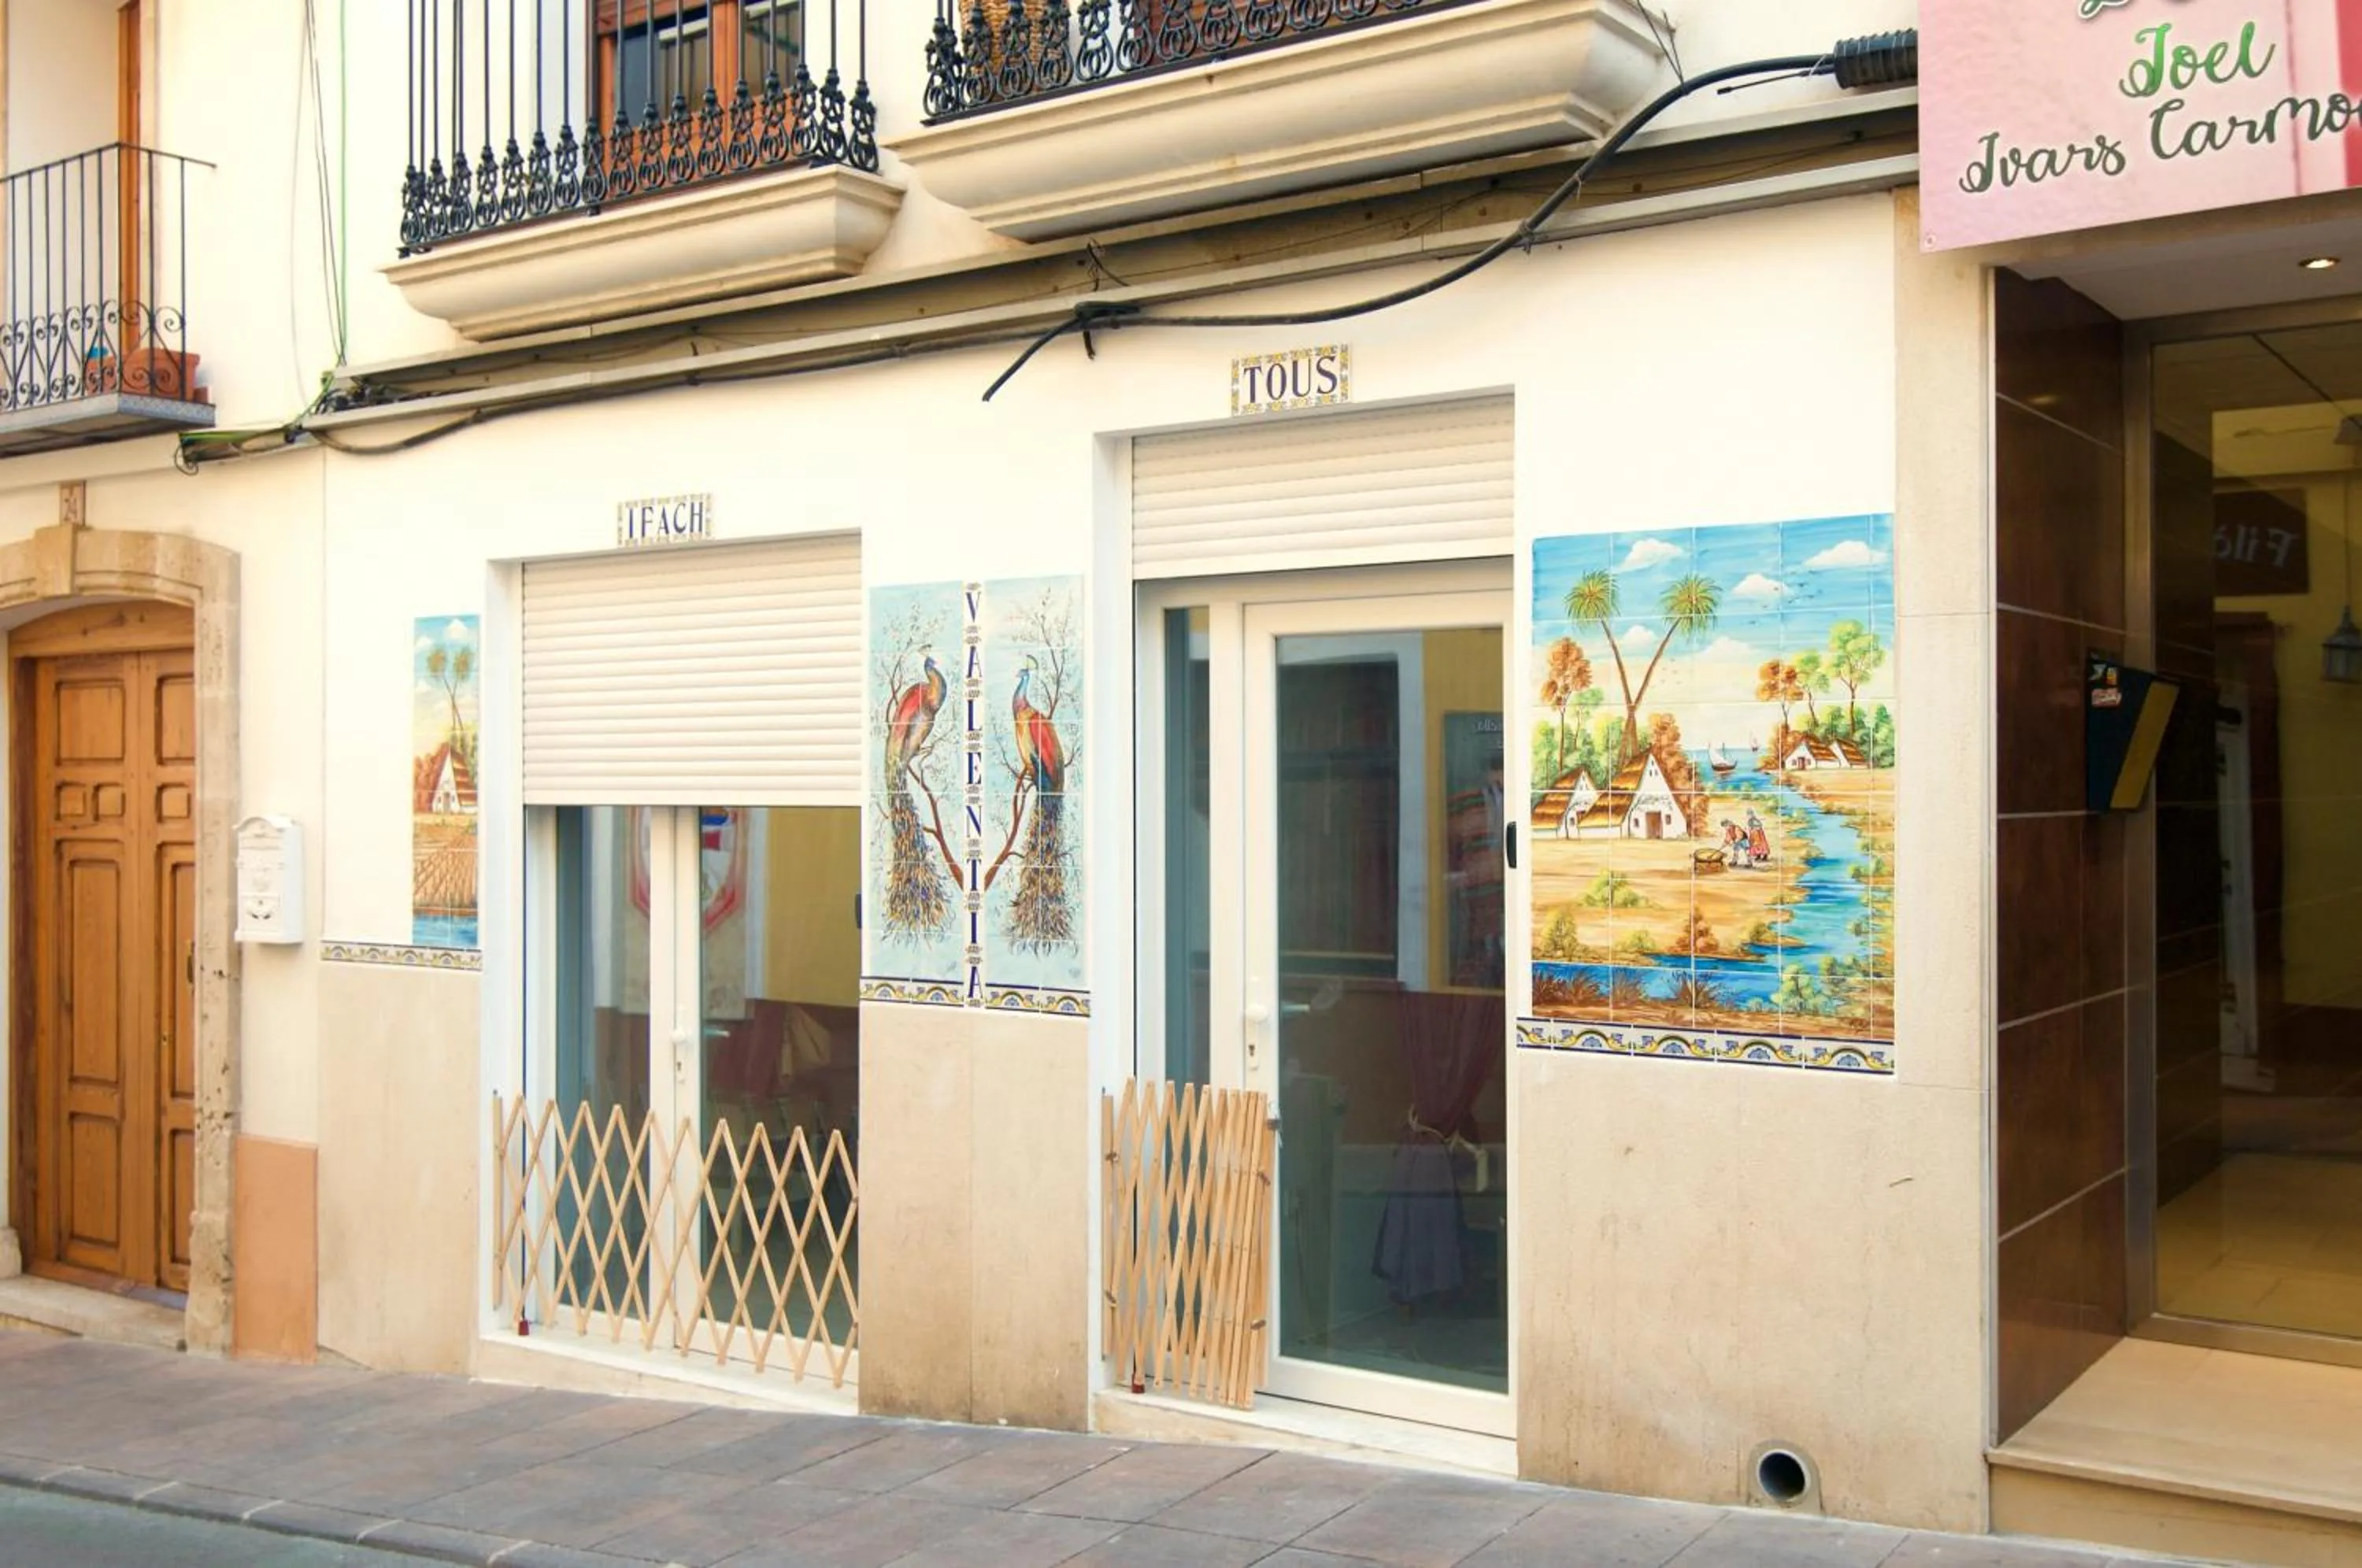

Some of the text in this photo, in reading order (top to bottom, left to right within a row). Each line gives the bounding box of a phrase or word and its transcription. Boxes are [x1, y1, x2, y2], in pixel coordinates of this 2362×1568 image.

[2119, 21, 2275, 98] Joel
[2149, 93, 2362, 160] Carmo
[1242, 355, 1338, 404] TOUS
[628, 501, 703, 538] IFACH
